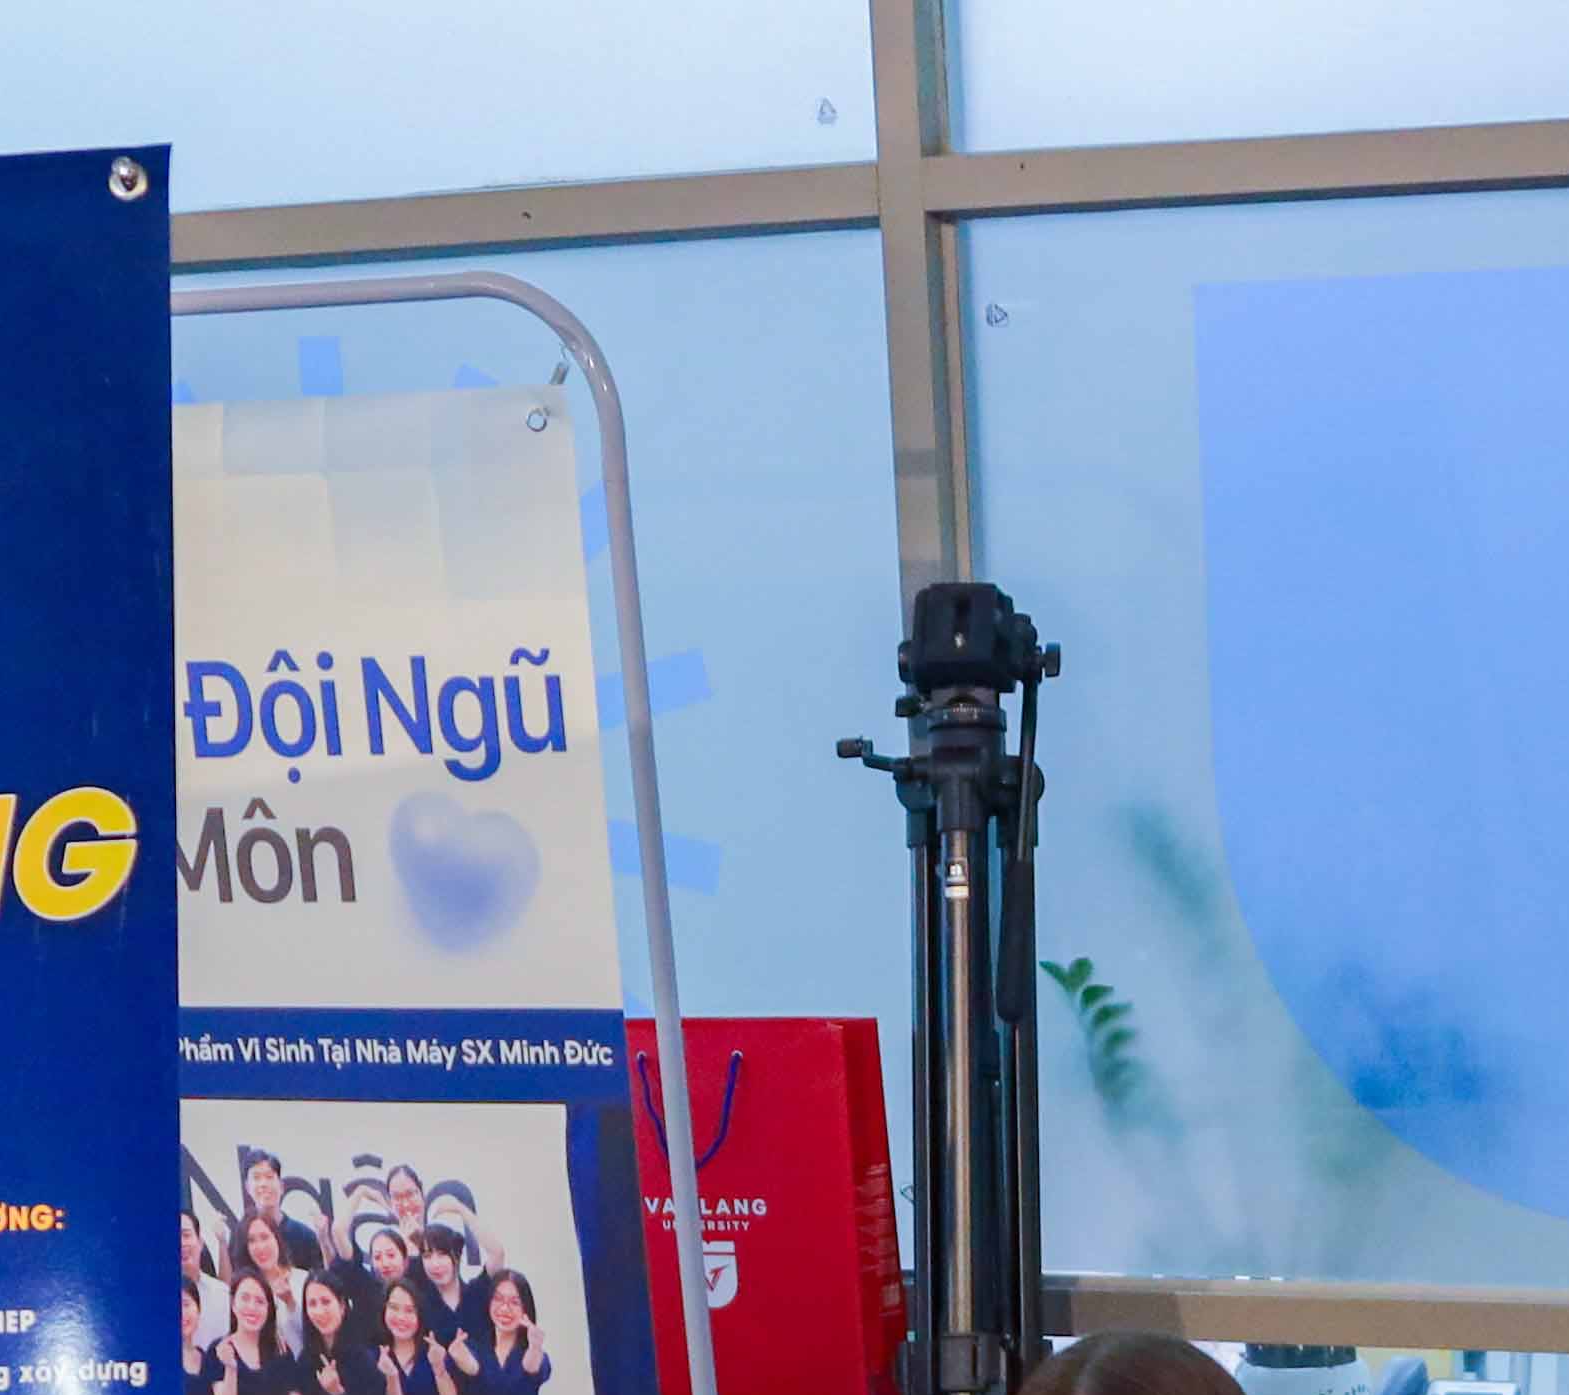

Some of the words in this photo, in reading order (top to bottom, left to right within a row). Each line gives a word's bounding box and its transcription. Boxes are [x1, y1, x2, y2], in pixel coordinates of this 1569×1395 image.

[182, 649, 342, 784] Đội
[361, 646, 568, 782] Ngũ
[238, 1037, 260, 1061] Vi
[265, 1038, 314, 1062] Sinh
[318, 1038, 350, 1069] Tại
[356, 1039, 401, 1063] Nhà
[405, 1039, 456, 1070] Máy
[461, 1040, 492, 1065] SX
[500, 1040, 558, 1065] Minh
[563, 1040, 613, 1066] Đức
[644, 1197, 676, 1214] VA
[700, 1198, 767, 1216] LANG
